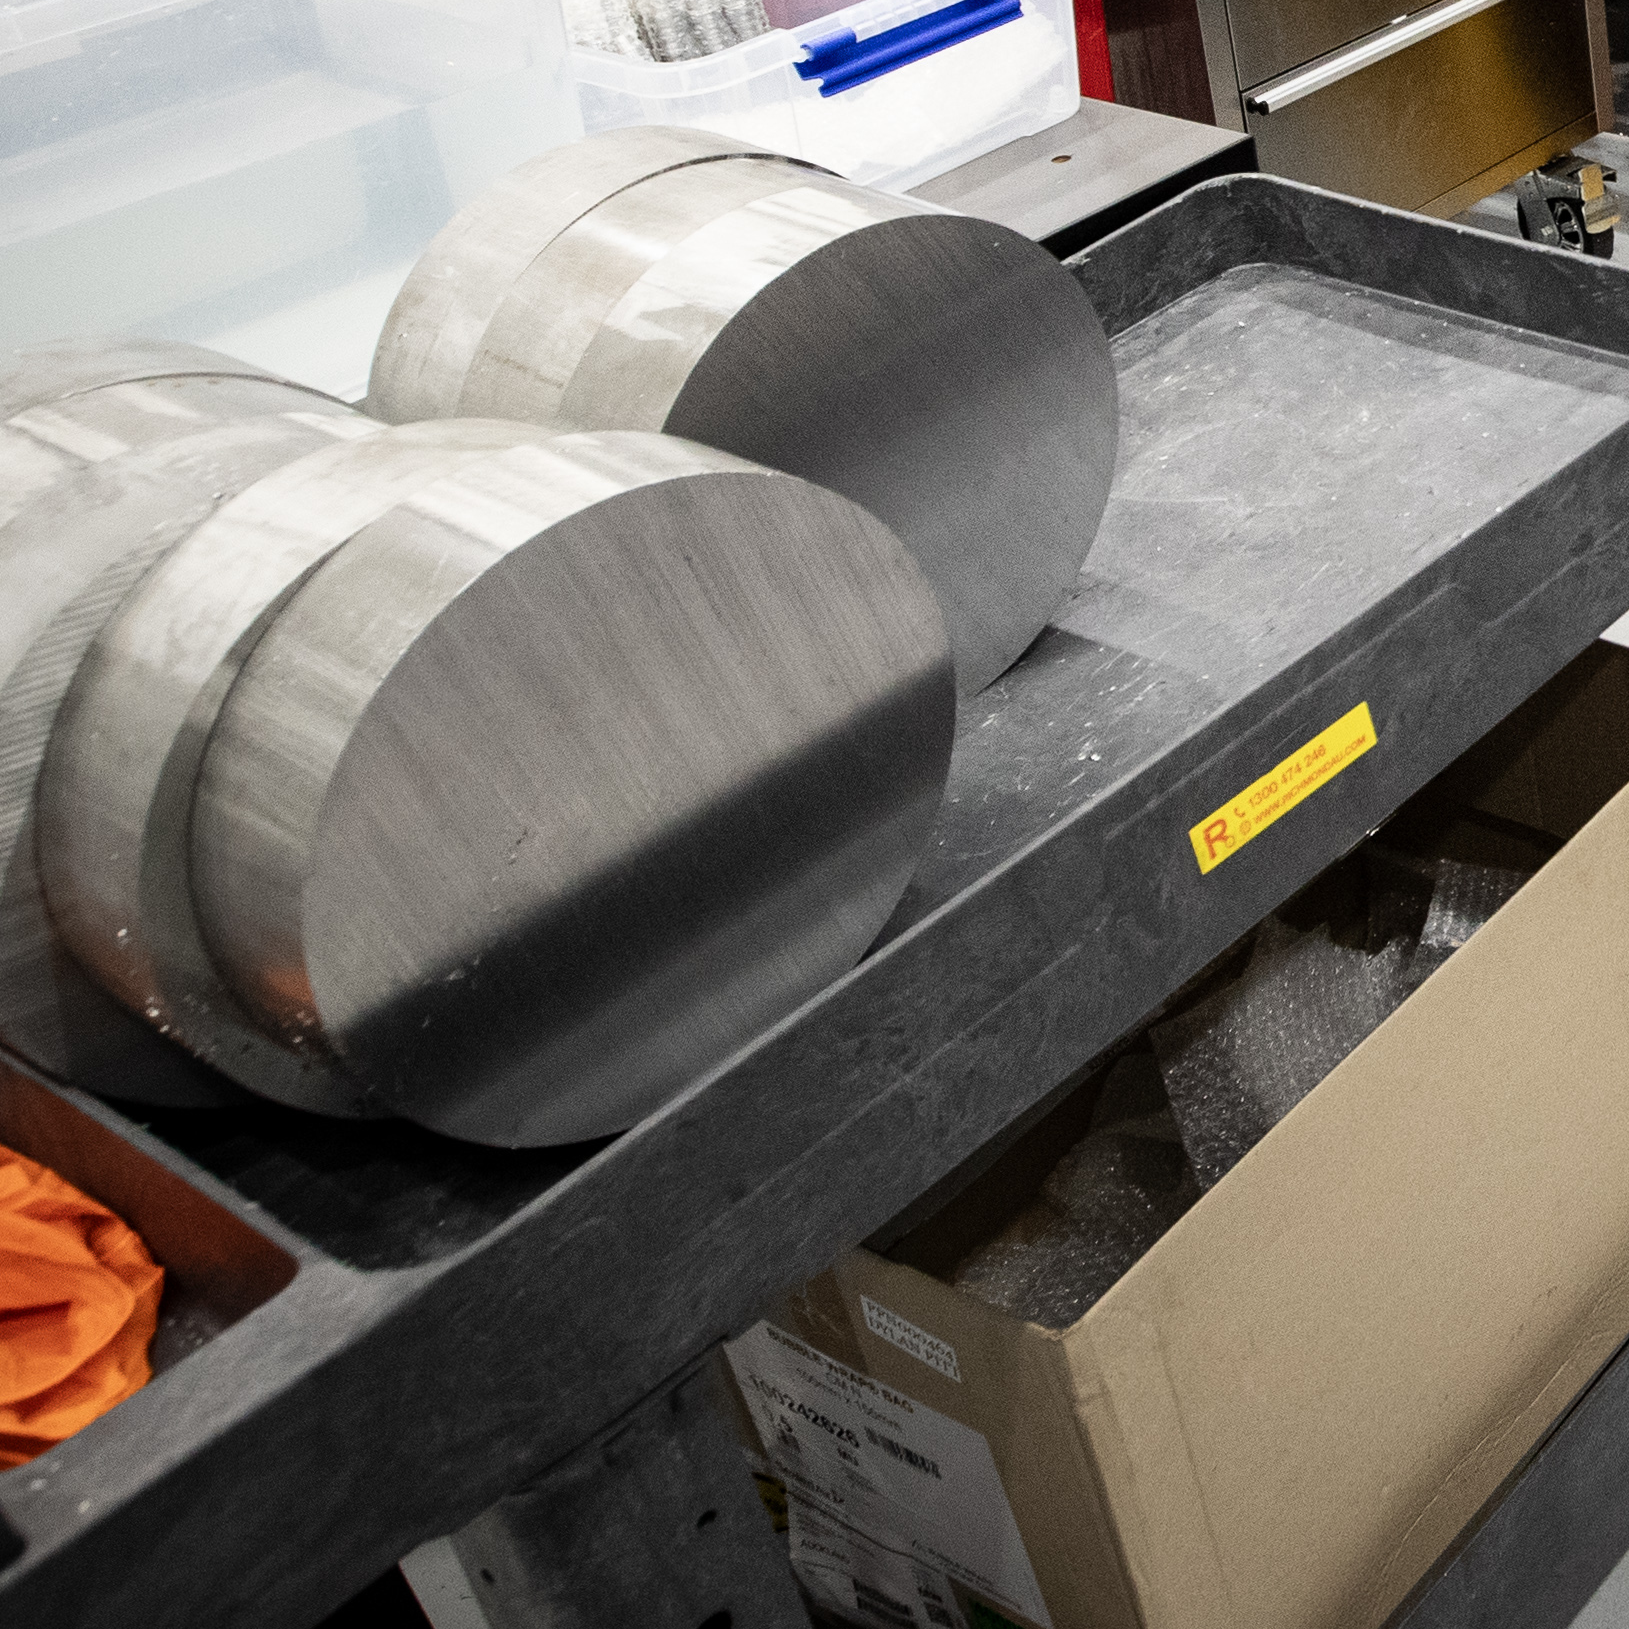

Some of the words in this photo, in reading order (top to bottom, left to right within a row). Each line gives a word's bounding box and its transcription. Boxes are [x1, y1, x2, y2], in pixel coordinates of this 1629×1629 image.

[1249, 780, 1279, 808] 1300
[1280, 762, 1303, 784] 474
[868, 1315, 923, 1355] DYLAN
[766, 1326, 827, 1367] BUBBLE
[881, 1388, 915, 1415] BAG
